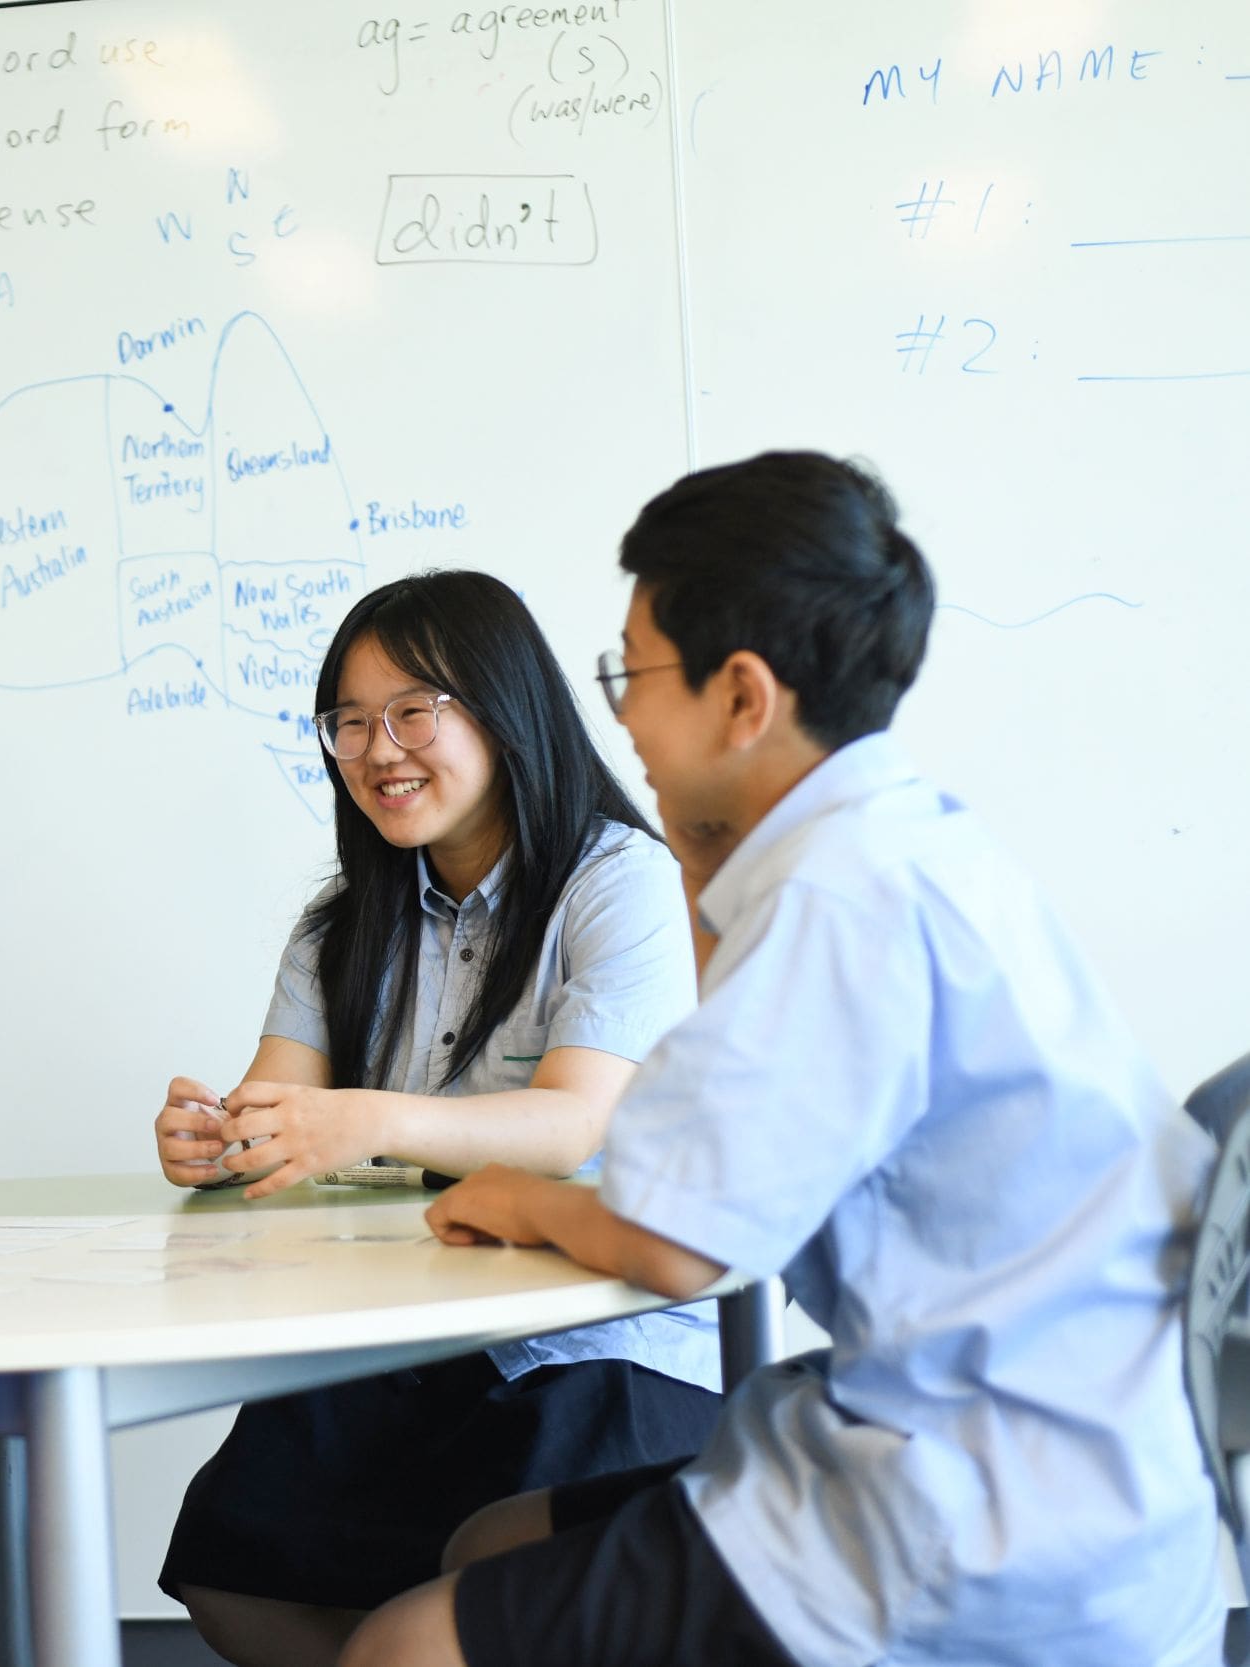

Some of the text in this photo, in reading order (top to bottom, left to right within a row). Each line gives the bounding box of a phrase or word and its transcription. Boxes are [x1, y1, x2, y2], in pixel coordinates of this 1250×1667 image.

[99, 38, 165, 68] use
[862, 57, 942, 106] MY
[95, 100, 192, 153] form
[226, 167, 250, 205] N
[392, 190, 561, 255] didn't
[117, 315, 207, 365] Darwin
[225, 432, 332, 483] Queensland
[365, 499, 470, 536] Brisbane
[0, 544, 88, 609] Australia
